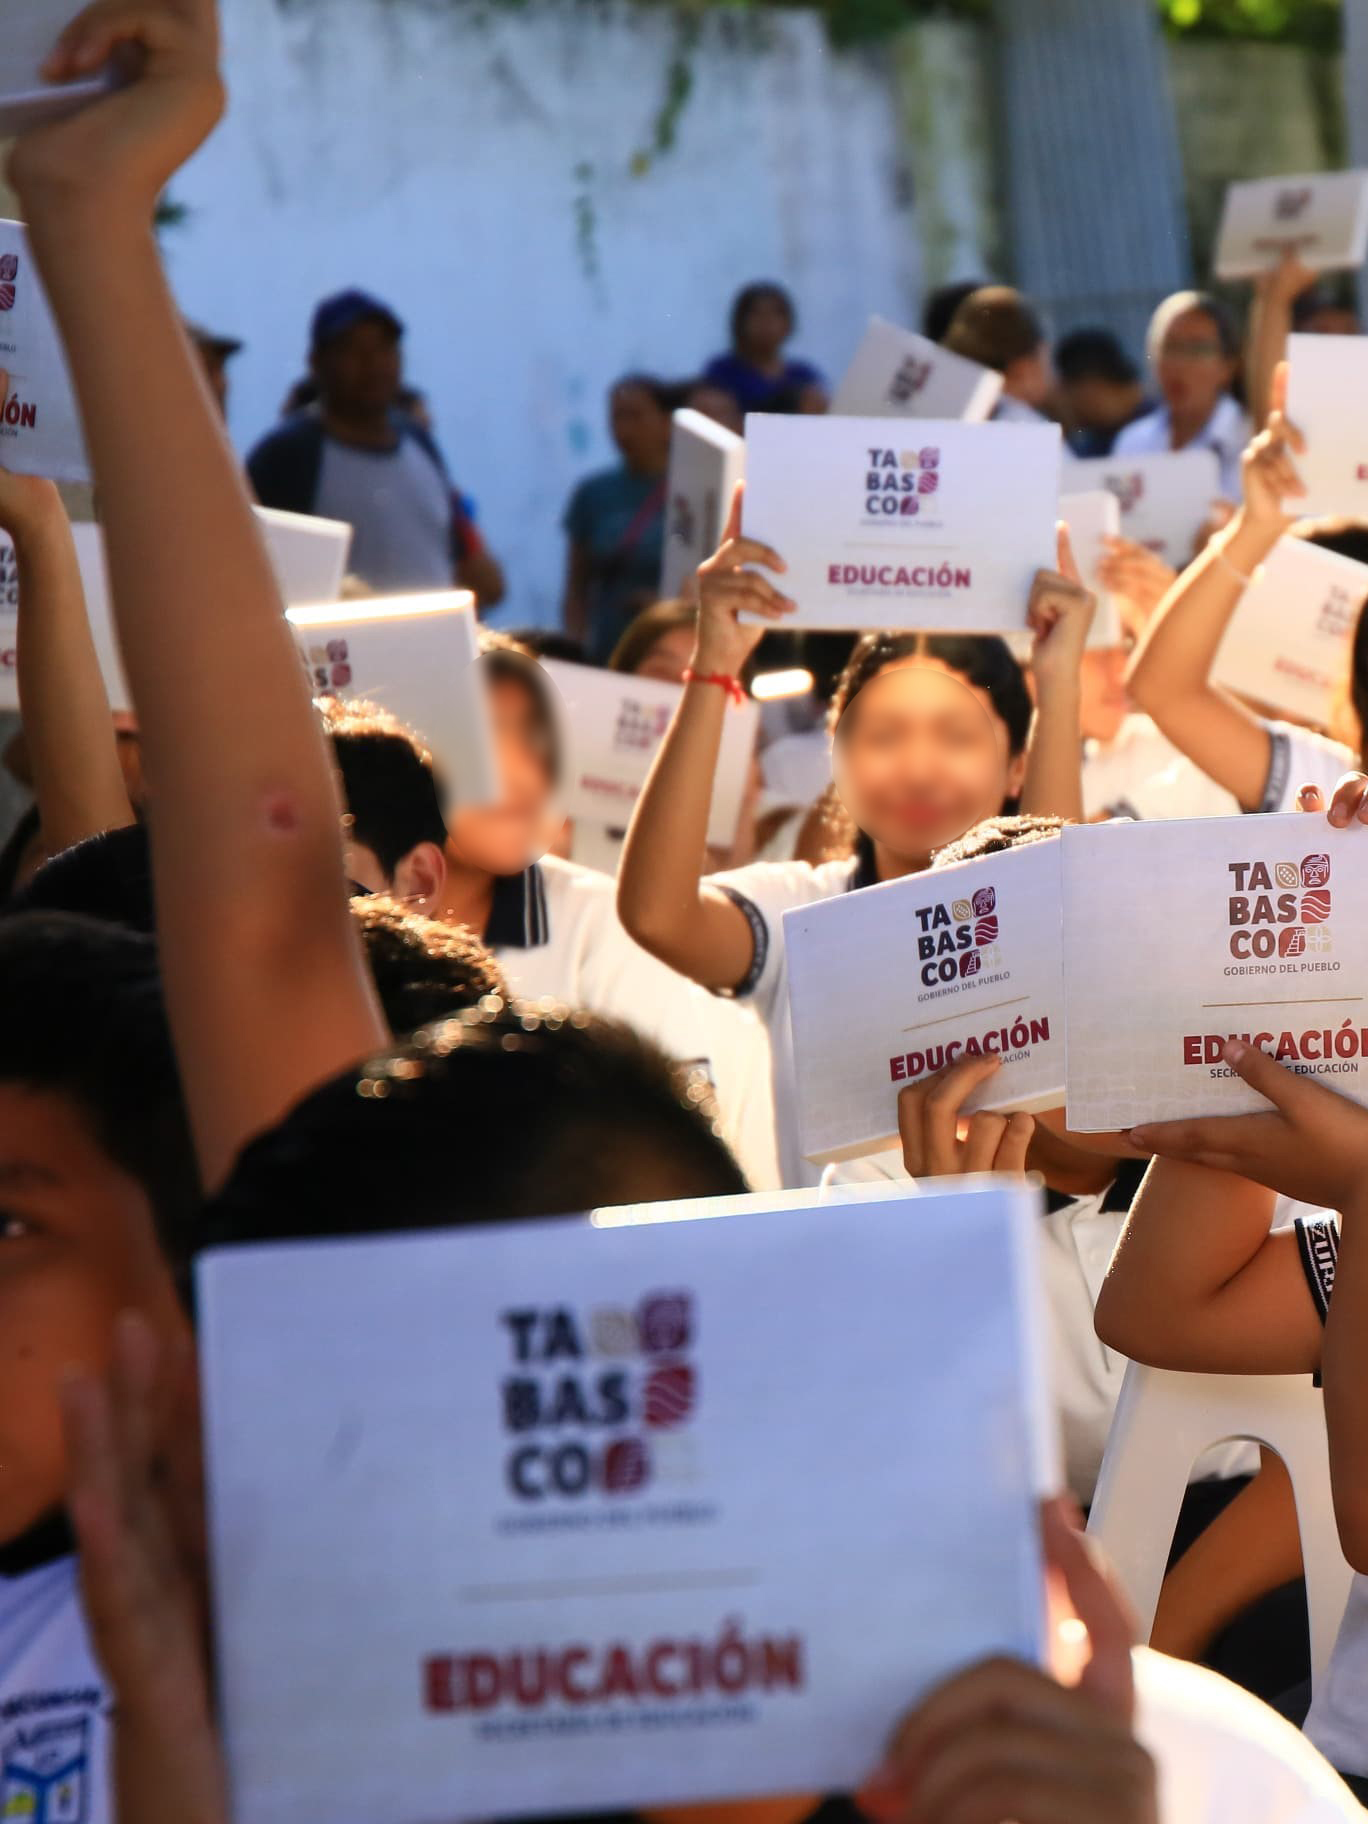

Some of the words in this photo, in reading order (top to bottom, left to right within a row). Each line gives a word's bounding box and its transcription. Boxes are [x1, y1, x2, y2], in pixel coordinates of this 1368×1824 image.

[868, 448, 898, 468] TA
[866, 472, 914, 492] BAS
[866, 496, 898, 515] CO
[828, 560, 971, 588] EDUCACIÓN
[1229, 862, 1272, 891] TA
[915, 904, 951, 932] TA
[1229, 893, 1297, 926] BAS
[917, 925, 973, 961] BAS
[1230, 928, 1276, 959] CO
[921, 957, 958, 987] CO
[1224, 964, 1277, 976] GOBIERNO
[1279, 963, 1299, 974] DEL
[1300, 961, 1341, 973] PUEBLO
[918, 985, 960, 1003] GOBIERNO
[961, 978, 977, 991] DEL
[978, 971, 1010, 986] PUEBLO
[890, 1015, 1050, 1081] EDUCACIÓN
[1294, 1062, 1359, 1075] EDUCACIÓN
[502, 1305, 581, 1362] TA
[503, 1370, 629, 1432] BAS
[509, 1441, 591, 1499] CO
[421, 1613, 805, 1715] EDUCACIÓN
